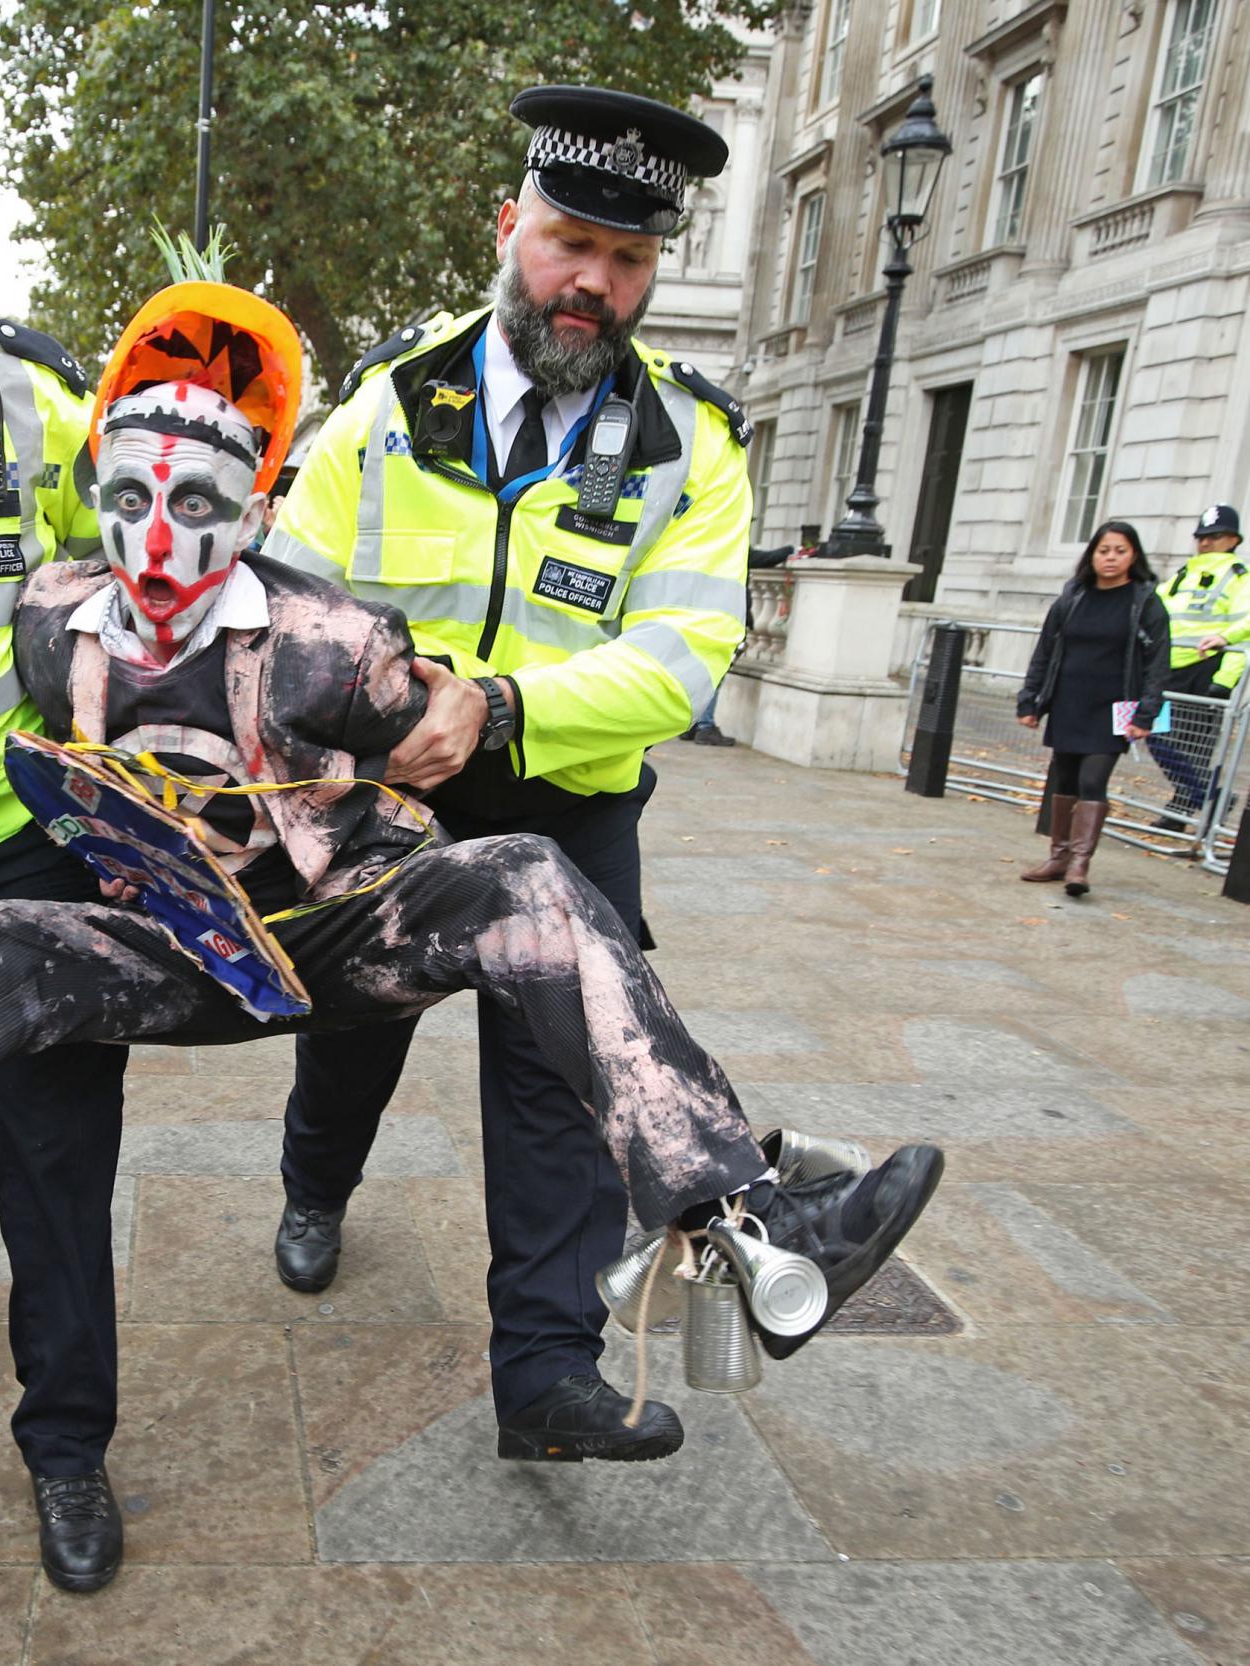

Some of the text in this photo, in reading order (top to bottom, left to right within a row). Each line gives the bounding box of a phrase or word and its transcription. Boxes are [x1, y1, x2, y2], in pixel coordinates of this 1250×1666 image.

[538, 582, 603, 609] POLICE OFFICER
[569, 578, 598, 593] POLICE
